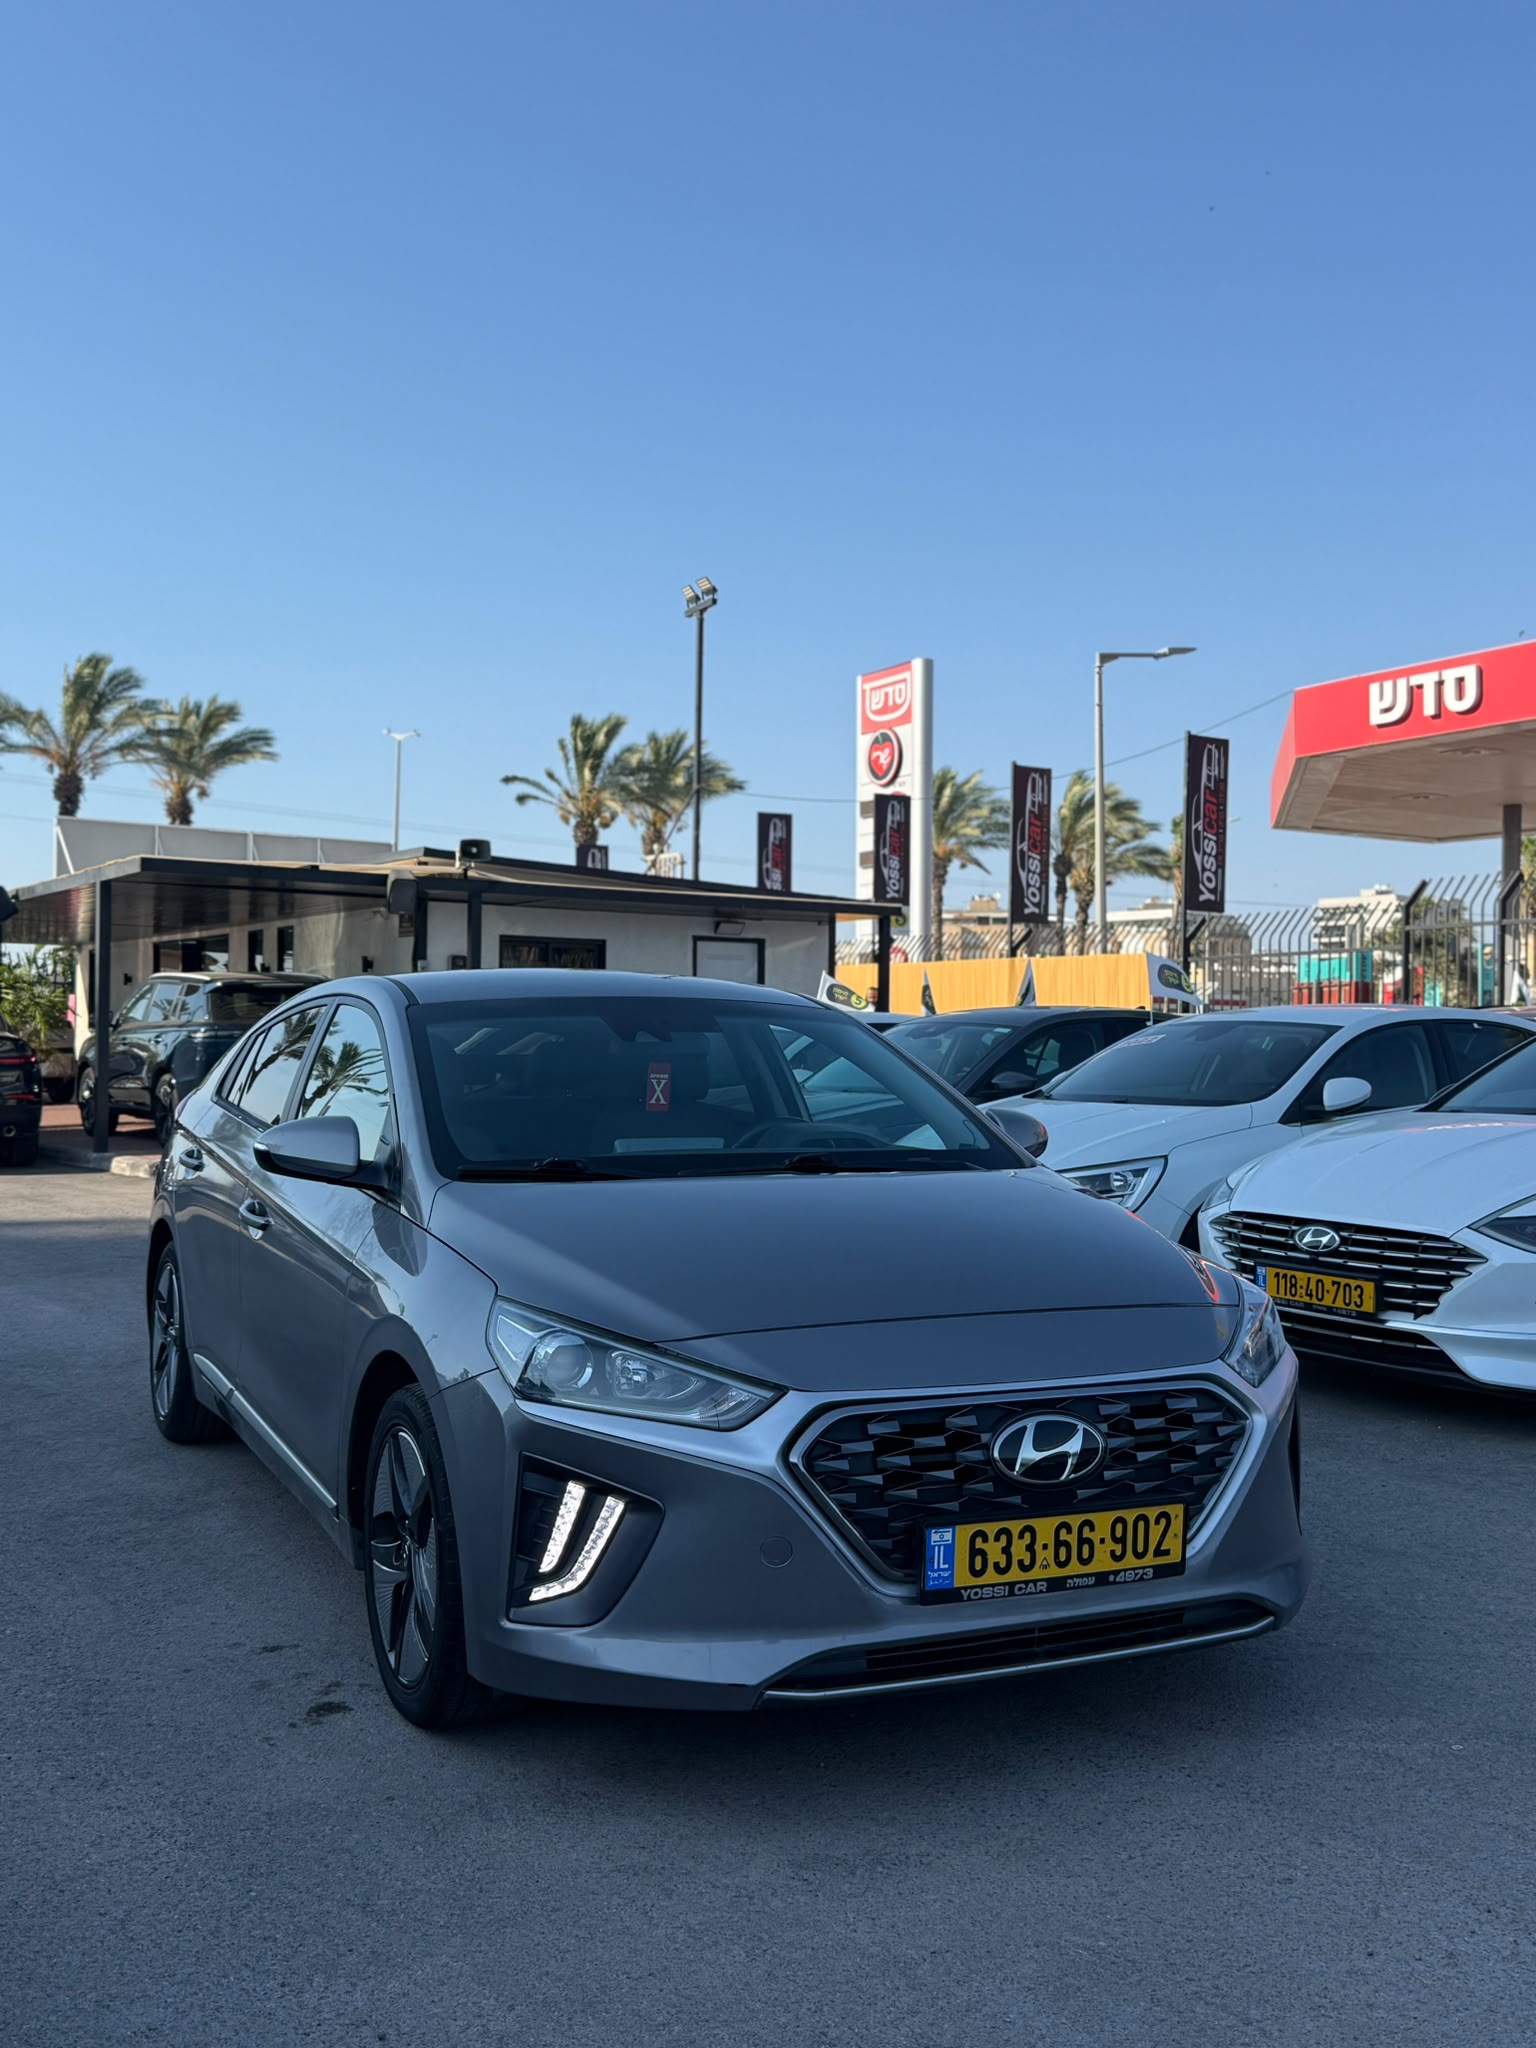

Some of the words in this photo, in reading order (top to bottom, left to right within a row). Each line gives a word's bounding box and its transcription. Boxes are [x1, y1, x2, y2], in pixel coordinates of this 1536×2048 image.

[871, 682, 906, 711] סדש
[1369, 664, 1481, 728] סדש
[648, 1079, 668, 1105] X
[934, 1545, 949, 1569] IL
[961, 1585, 1009, 1601] YOSSI
[1014, 1581, 1048, 1595] CAR
